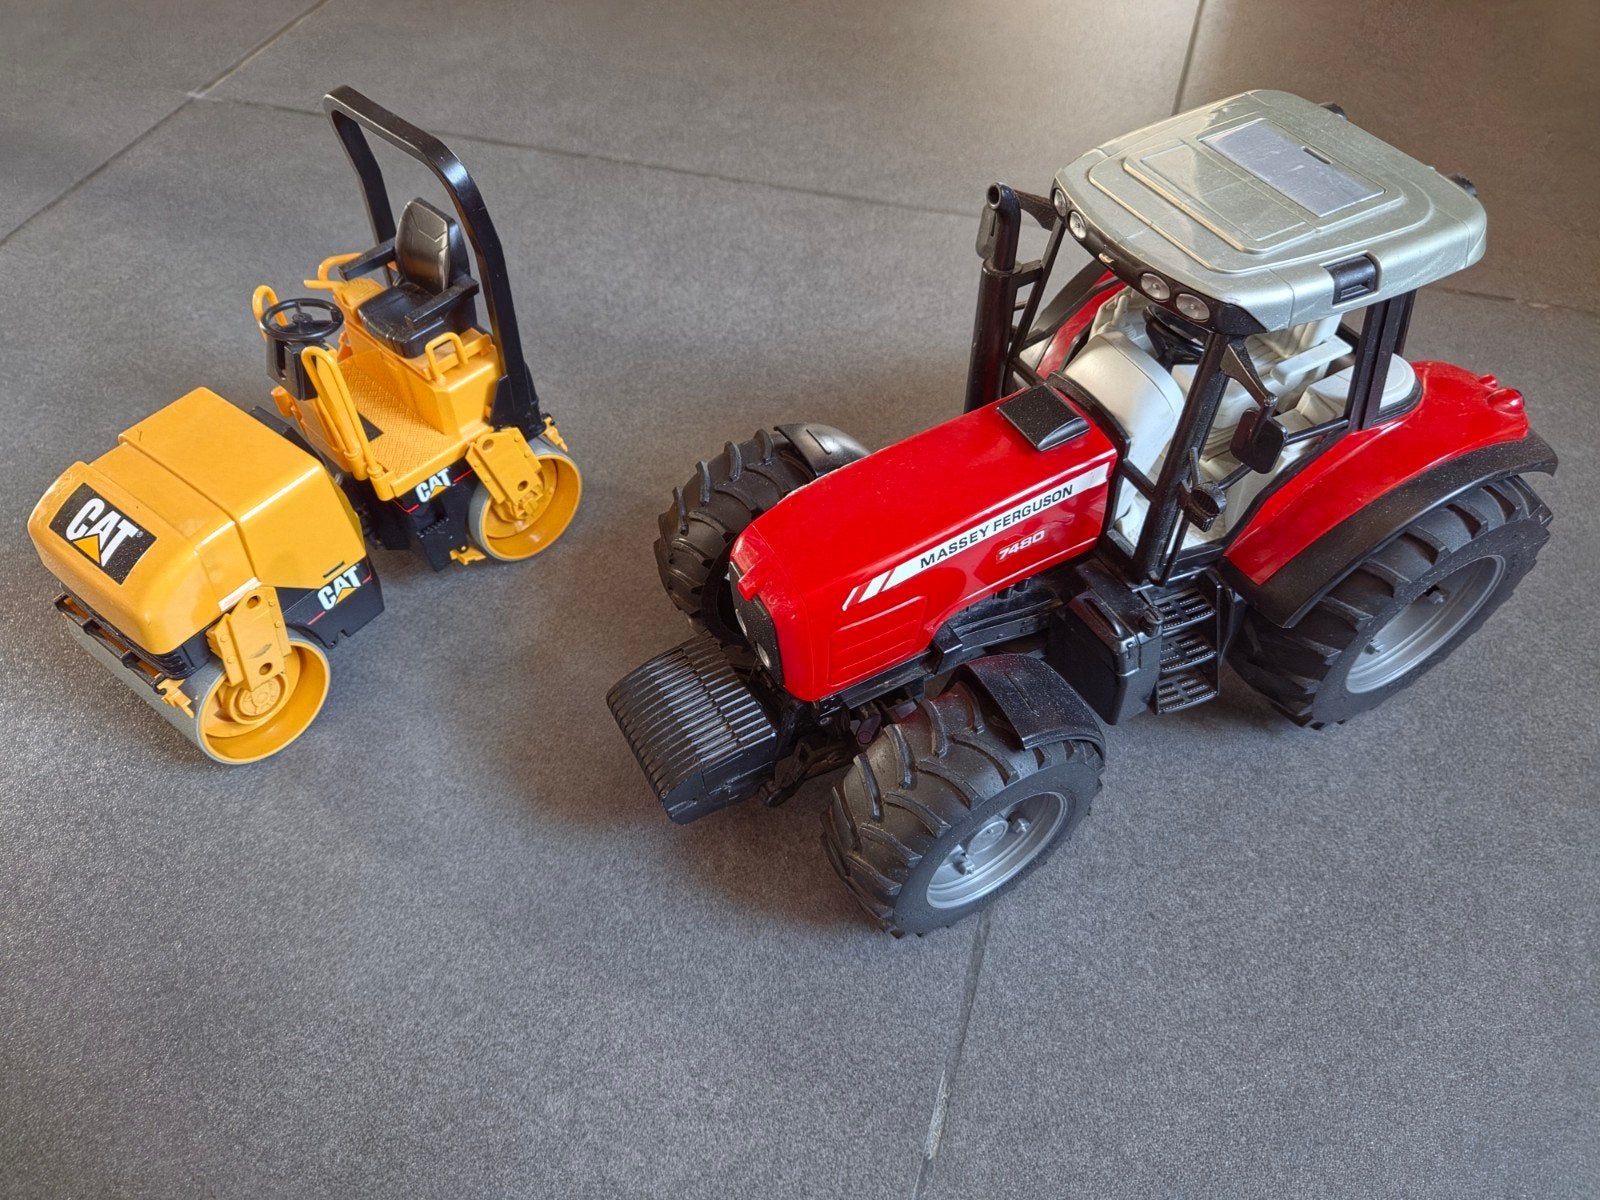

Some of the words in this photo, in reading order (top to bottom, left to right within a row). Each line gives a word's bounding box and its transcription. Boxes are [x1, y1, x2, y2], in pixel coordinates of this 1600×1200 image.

[414, 467, 451, 503] CAT
[66, 498, 140, 567] CAT
[920, 525, 989, 568] MASSEY
[993, 484, 1073, 532] FERGUSON
[998, 529, 1046, 560] 7480
[317, 565, 362, 611] CAT
